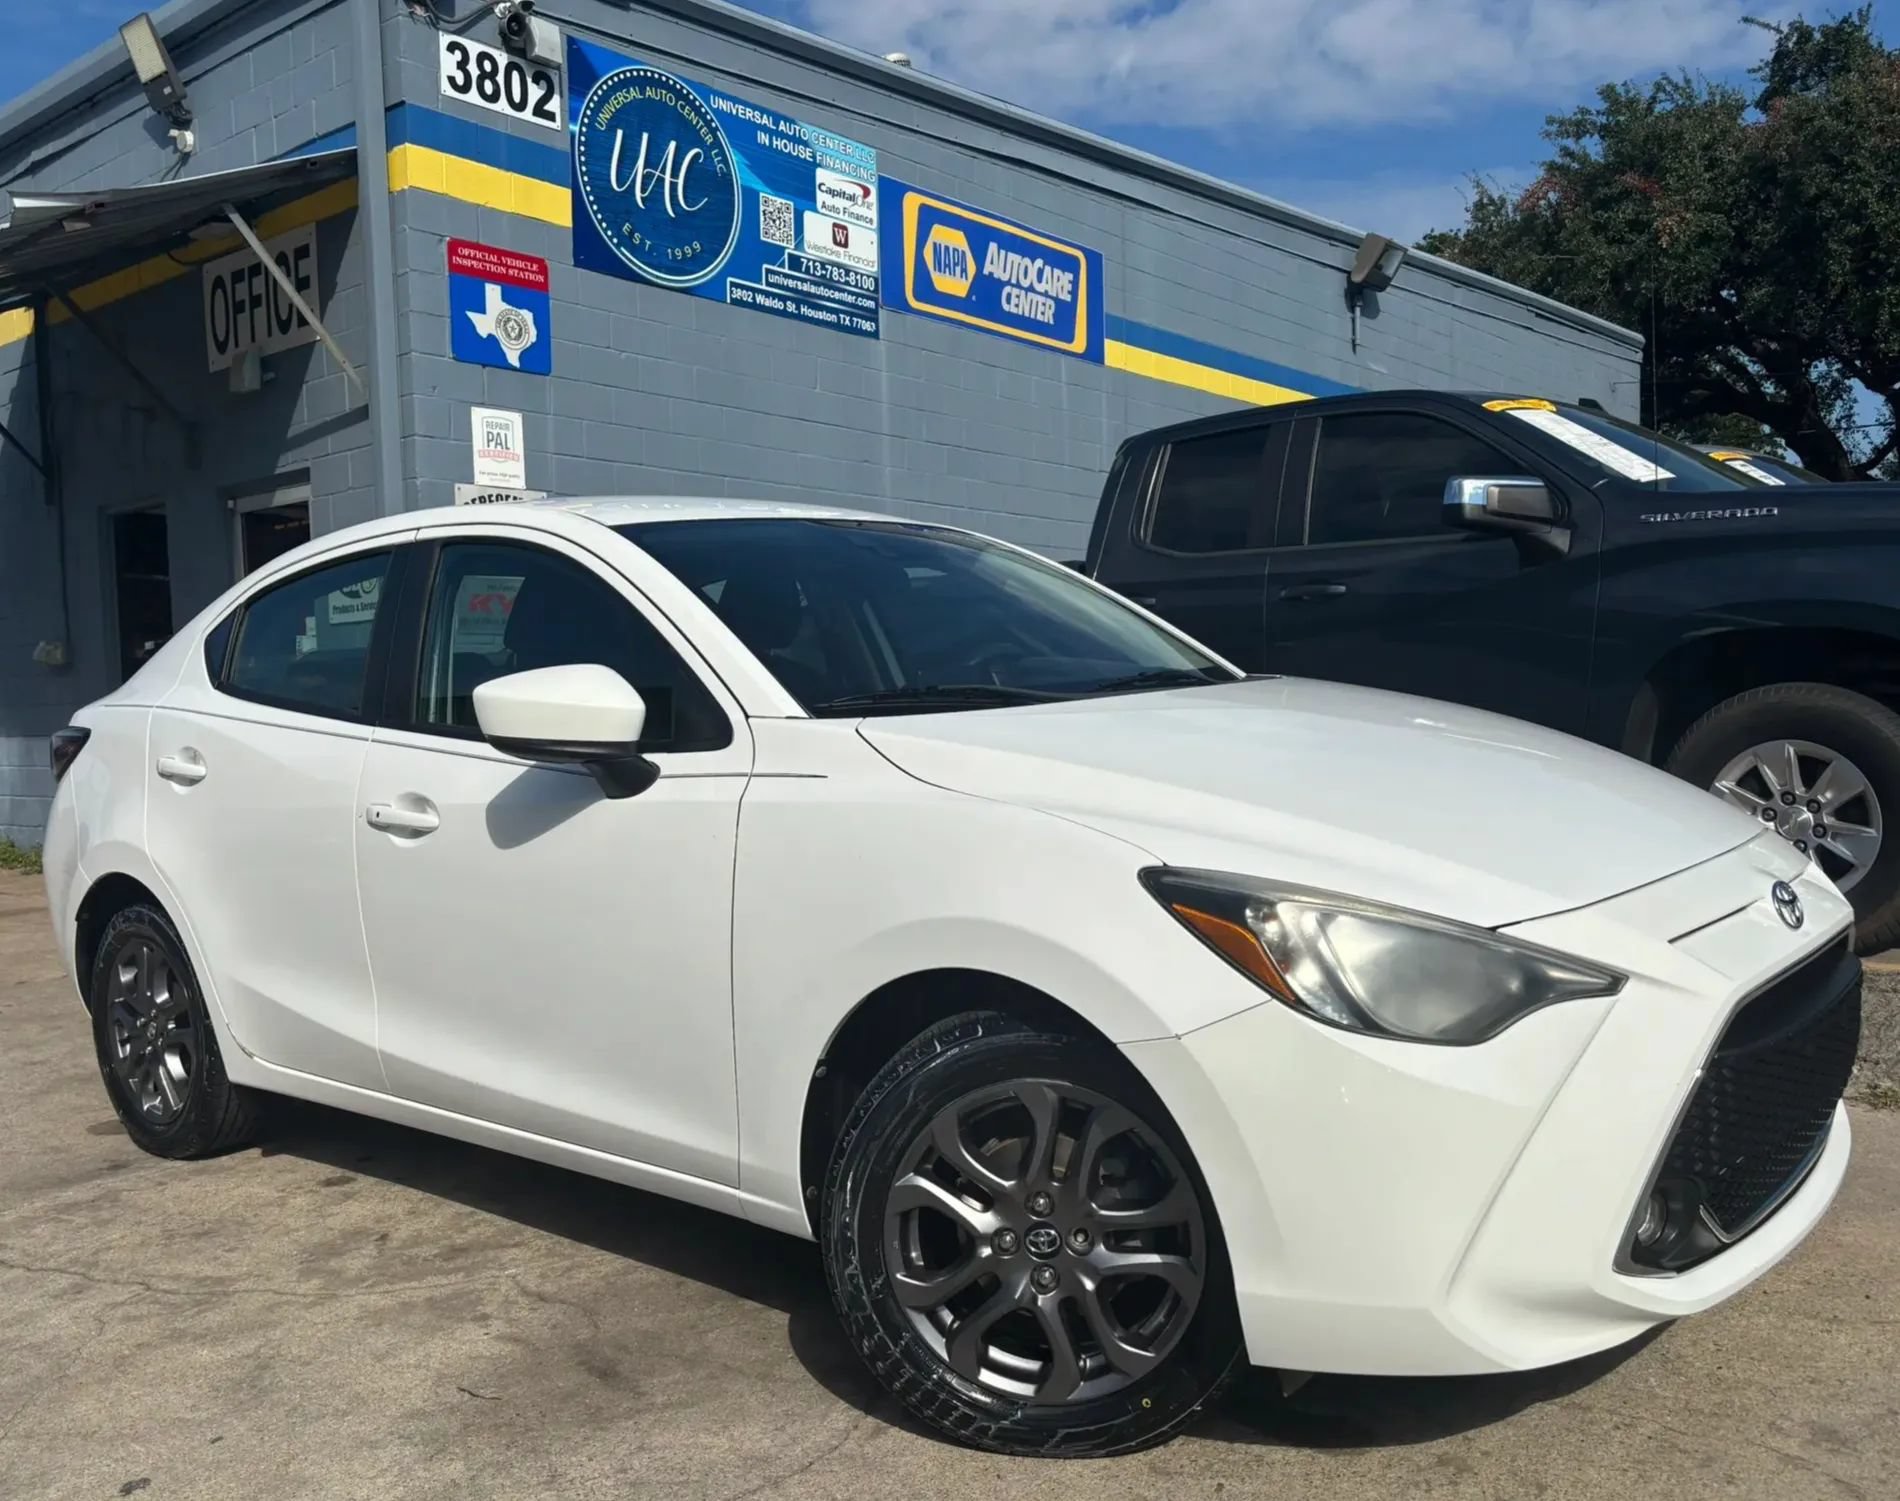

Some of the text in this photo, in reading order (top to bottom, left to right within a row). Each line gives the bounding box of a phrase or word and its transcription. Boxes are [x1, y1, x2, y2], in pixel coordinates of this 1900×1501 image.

[446, 41, 556, 123] 3802
[595, 86, 643, 131] UNIVERSAL
[646, 86, 675, 107] AUTO
[677, 100, 713, 146] CENTER
[710, 94, 875, 164] UNIVERSAL AUTO CENTER LLC
[610, 128, 708, 218] UAC
[757, 131, 876, 182] IN HOUSE FINANCING
[821, 200, 874, 226] Auto Finance
[667, 240, 702, 260] 1999
[833, 227, 847, 245] W
[452, 256, 545, 283] INSPECTION STATION
[458, 247, 539, 272] OFFICIAL VEHICLE
[799, 258, 875, 291] 713-783-8100
[932, 241, 968, 281] NAPA
[210, 243, 311, 355] OFFICE
[731, 287, 753, 303] 3802
[754, 293, 784, 310] Waldo
[800, 304, 837, 323] Houston
[839, 313, 851, 327] TX
[768, 272, 876, 309] universalautocenter.com
[1001, 285, 1056, 325] CENTER
[485, 420, 510, 432] REPAIR
[486, 431, 510, 450] PAL
[1640, 506, 1779, 523] SILVERADO
